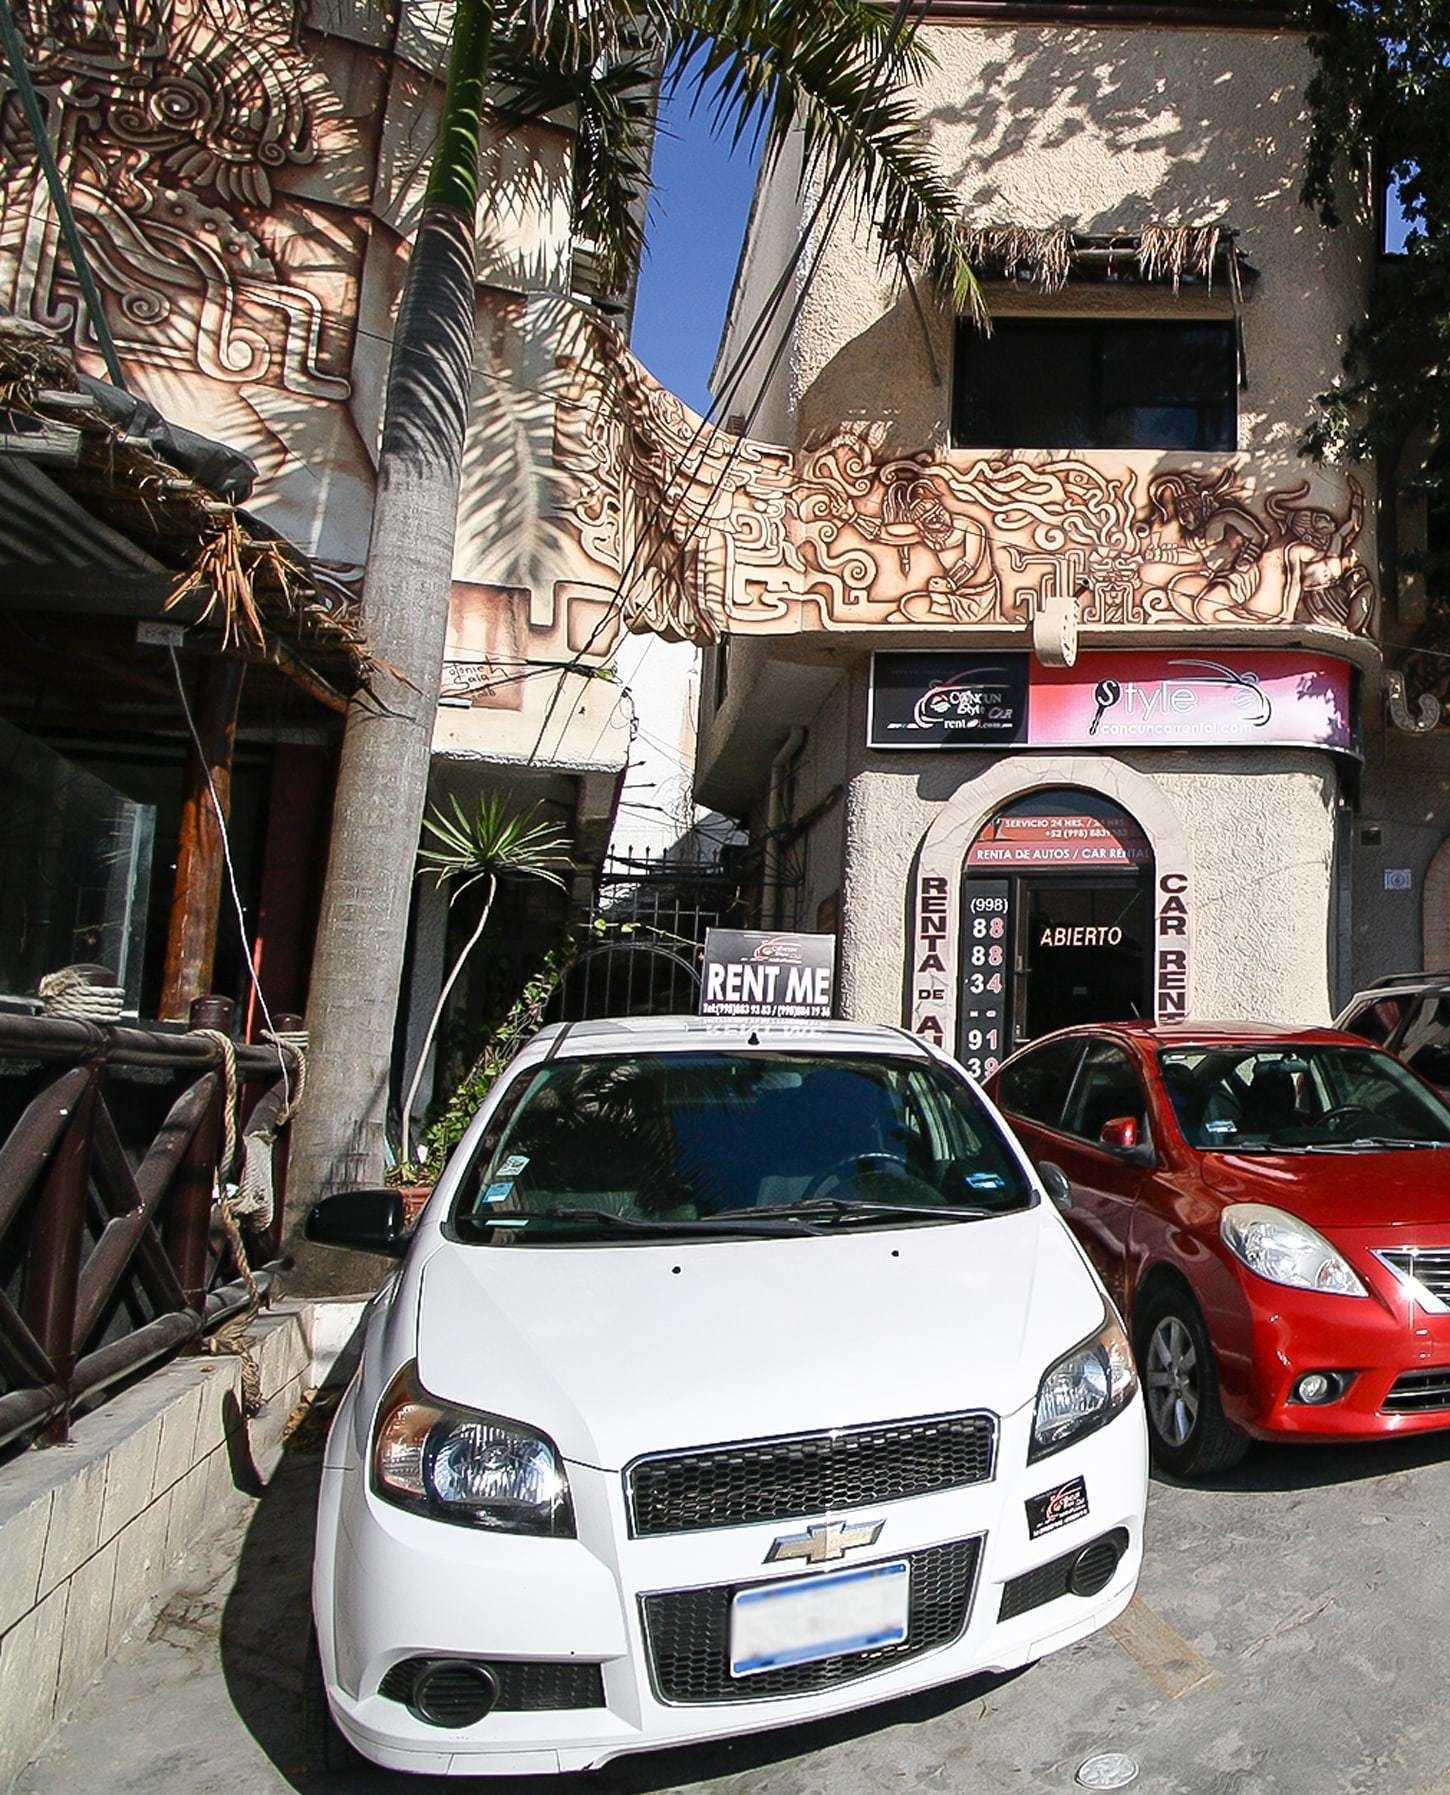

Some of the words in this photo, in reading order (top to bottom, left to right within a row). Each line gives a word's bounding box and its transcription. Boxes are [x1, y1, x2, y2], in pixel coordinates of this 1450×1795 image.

[1005, 818, 1049, 828] SERVICIO
[977, 849, 1012, 861] RENTA
[1015, 849, 1030, 861] DE
[1034, 848, 1070, 860] AUTOS
[1082, 848, 1106, 859] CAR
[1109, 848, 1149, 860] RENTAL
[970, 898, 1009, 914] (998)
[1159, 874, 1189, 935] CAR
[918, 877, 948, 972] RENTA
[1040, 926, 1122, 947] ABIERTO
[706, 963, 781, 1003] RENT
[785, 966, 831, 1005] ME
[918, 989, 945, 1000] DE
